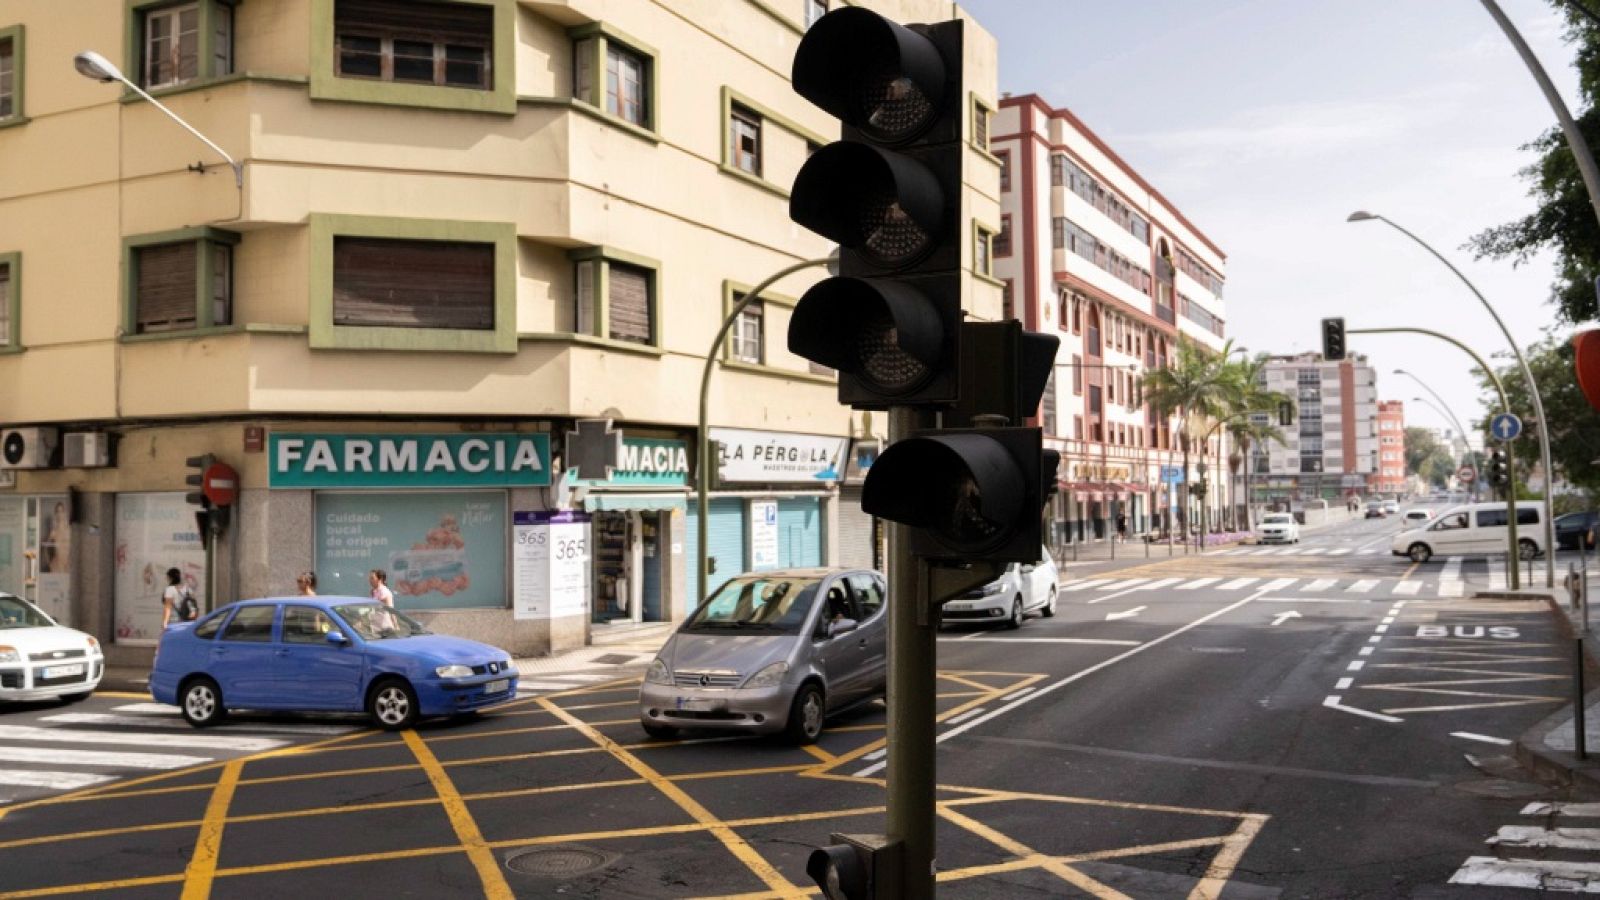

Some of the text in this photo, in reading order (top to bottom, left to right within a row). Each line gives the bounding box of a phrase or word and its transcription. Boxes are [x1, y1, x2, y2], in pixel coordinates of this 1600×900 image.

[277, 439, 542, 473] FARMACIA
[722, 444, 744, 460] LA
[326, 513, 380, 523] Cuidado
[326, 525, 362, 535] bucal
[326, 536, 388, 548] de origen
[518, 532, 547, 545] 365
[325, 548, 371, 558] natural
[556, 538, 586, 560] 365
[1416, 625, 1520, 638] BUS
